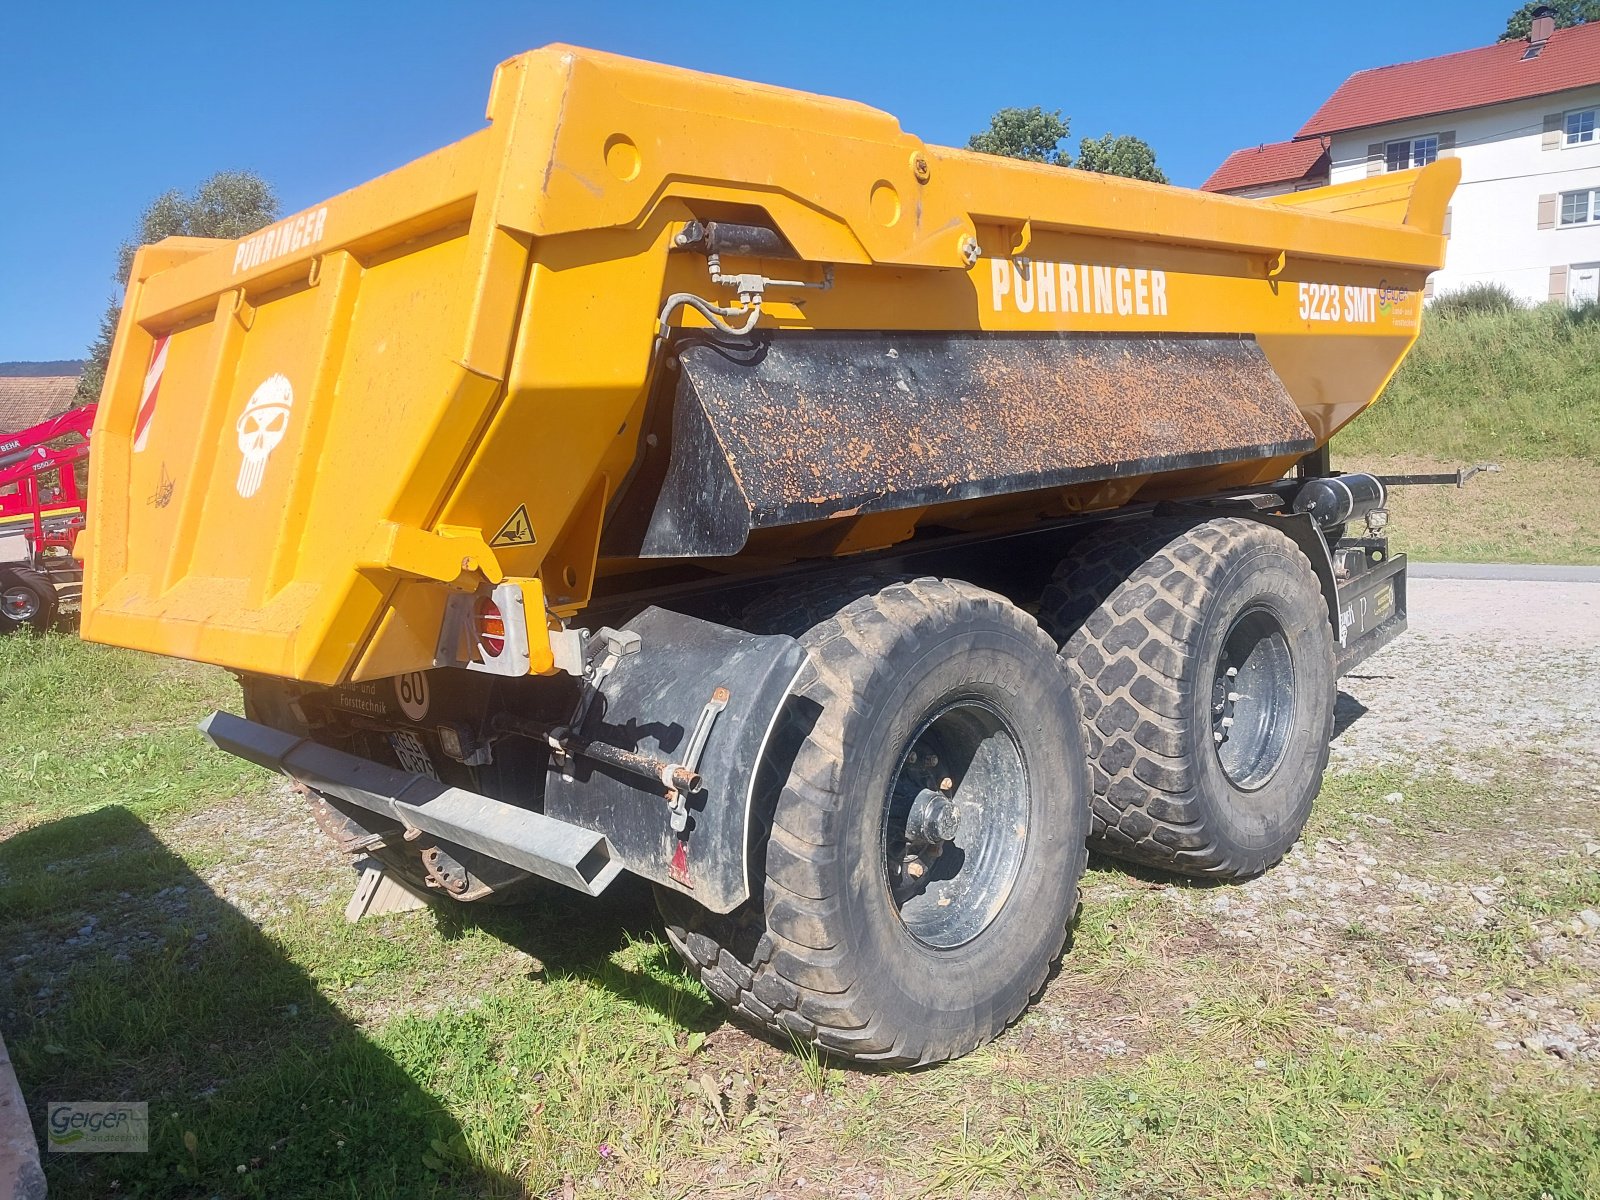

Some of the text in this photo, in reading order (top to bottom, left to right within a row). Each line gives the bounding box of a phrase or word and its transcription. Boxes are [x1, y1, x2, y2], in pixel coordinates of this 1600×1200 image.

[1298, 281, 1377, 323] 5223 SMT
[361, 683, 376, 695] und
[400, 671, 425, 706] 60
[340, 693, 387, 715] Forsttechnik
